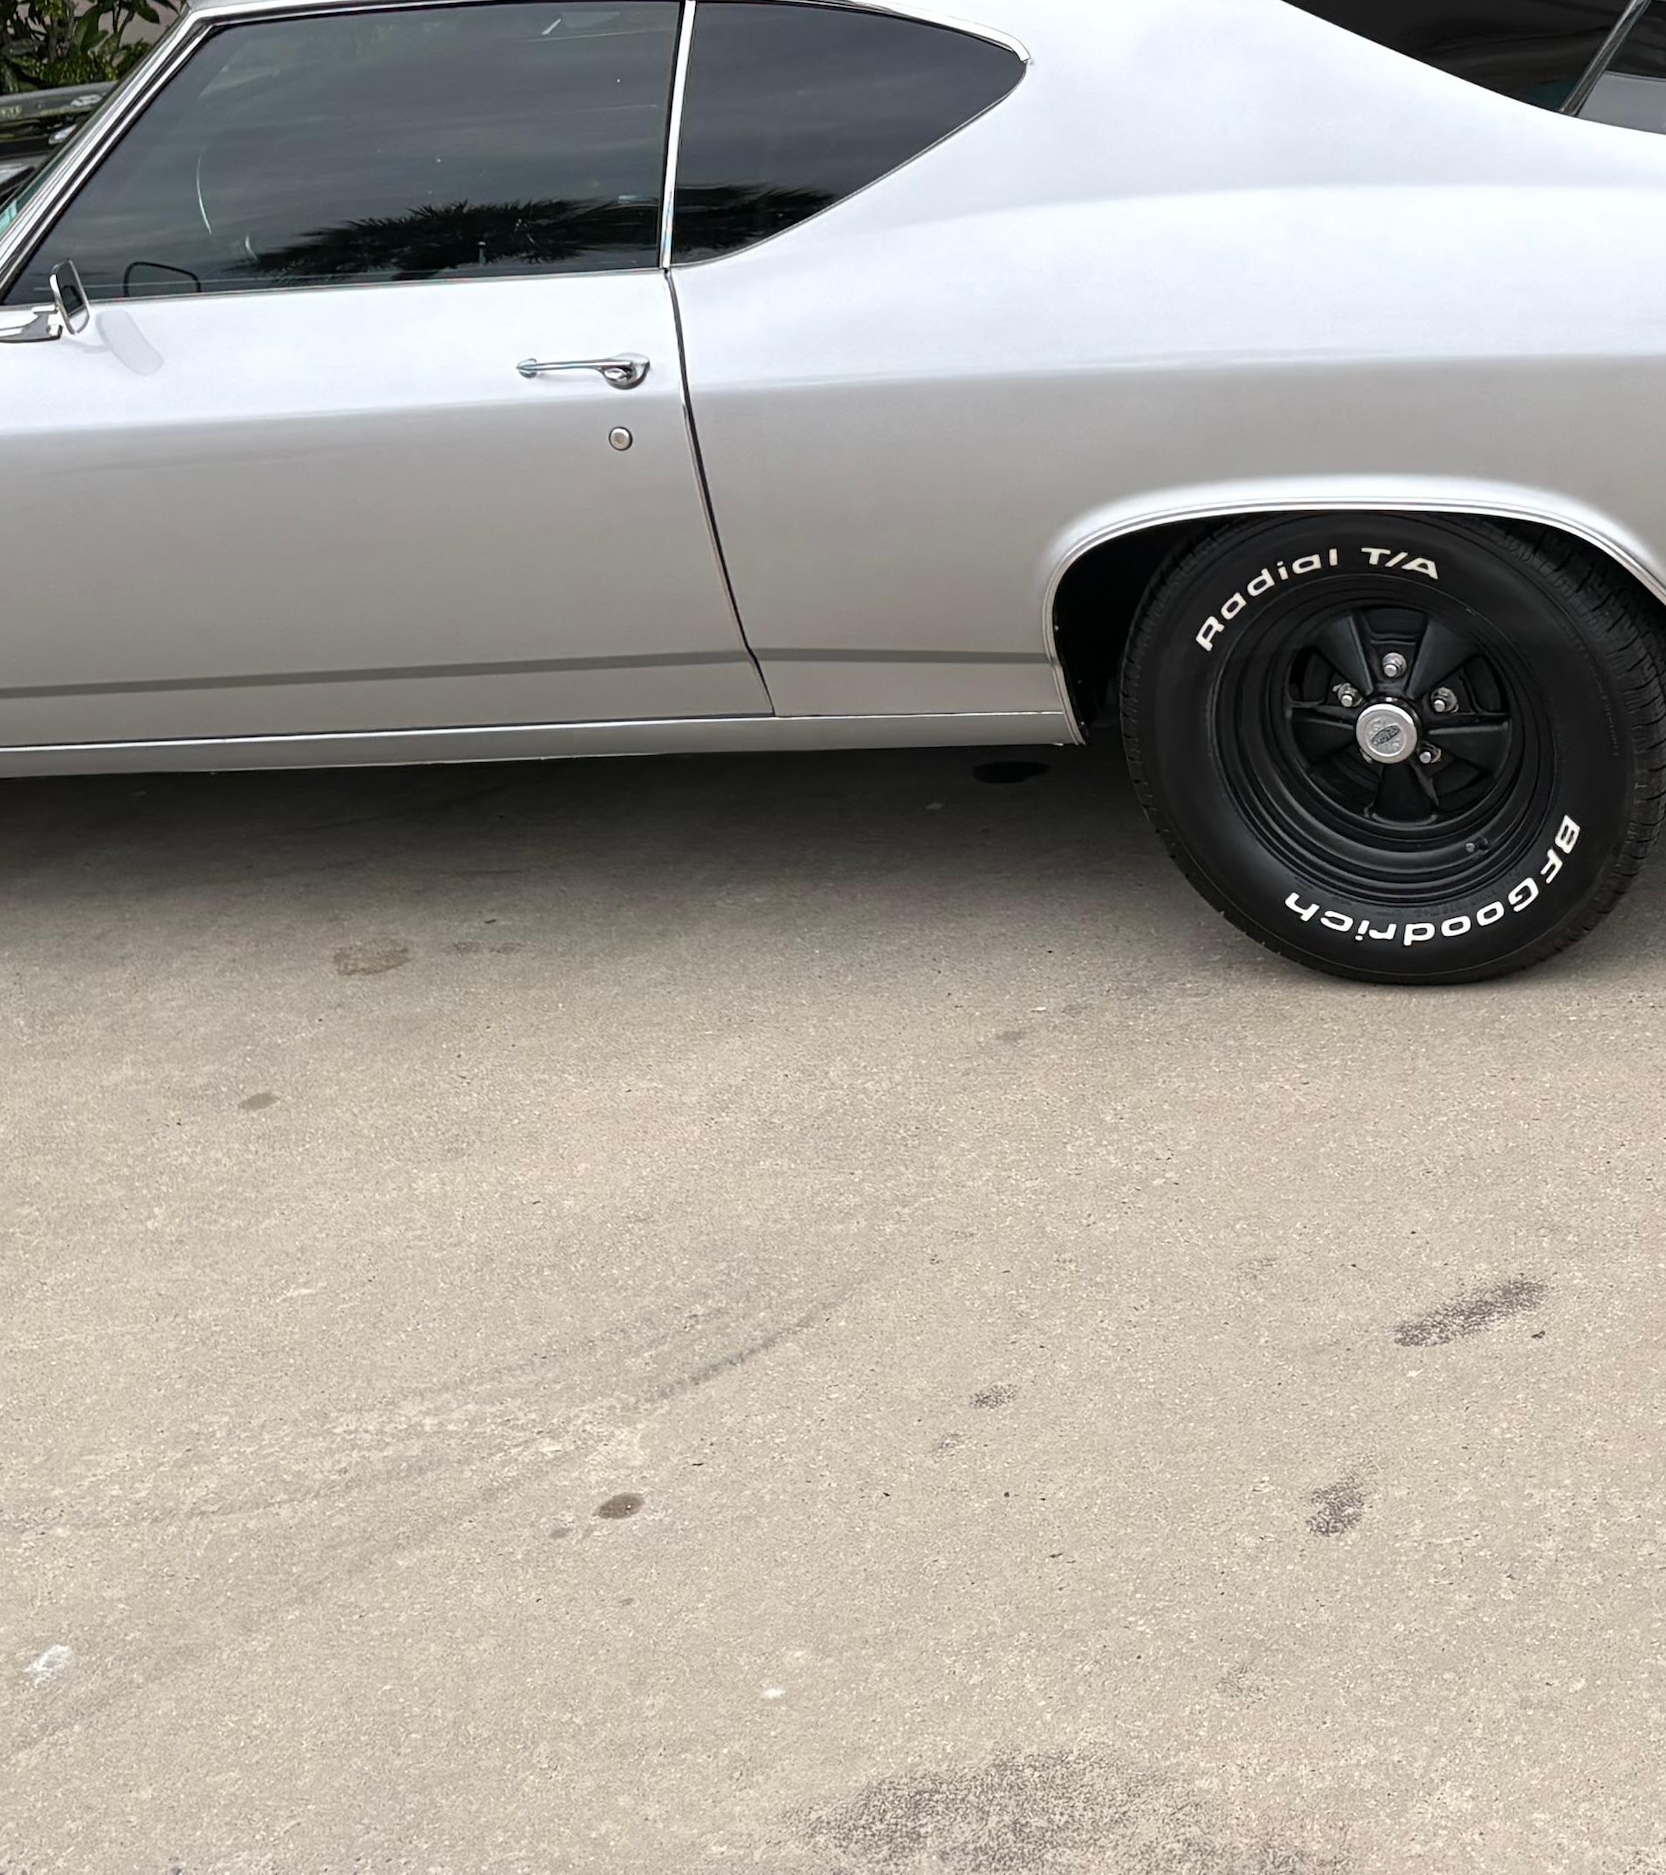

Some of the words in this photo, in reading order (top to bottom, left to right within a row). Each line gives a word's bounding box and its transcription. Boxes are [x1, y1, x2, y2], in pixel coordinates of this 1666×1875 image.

[1194, 547, 1339, 652] Radial
[1360, 546, 1440, 581] T/A
[1284, 813, 1582, 947] BFGoodrich
